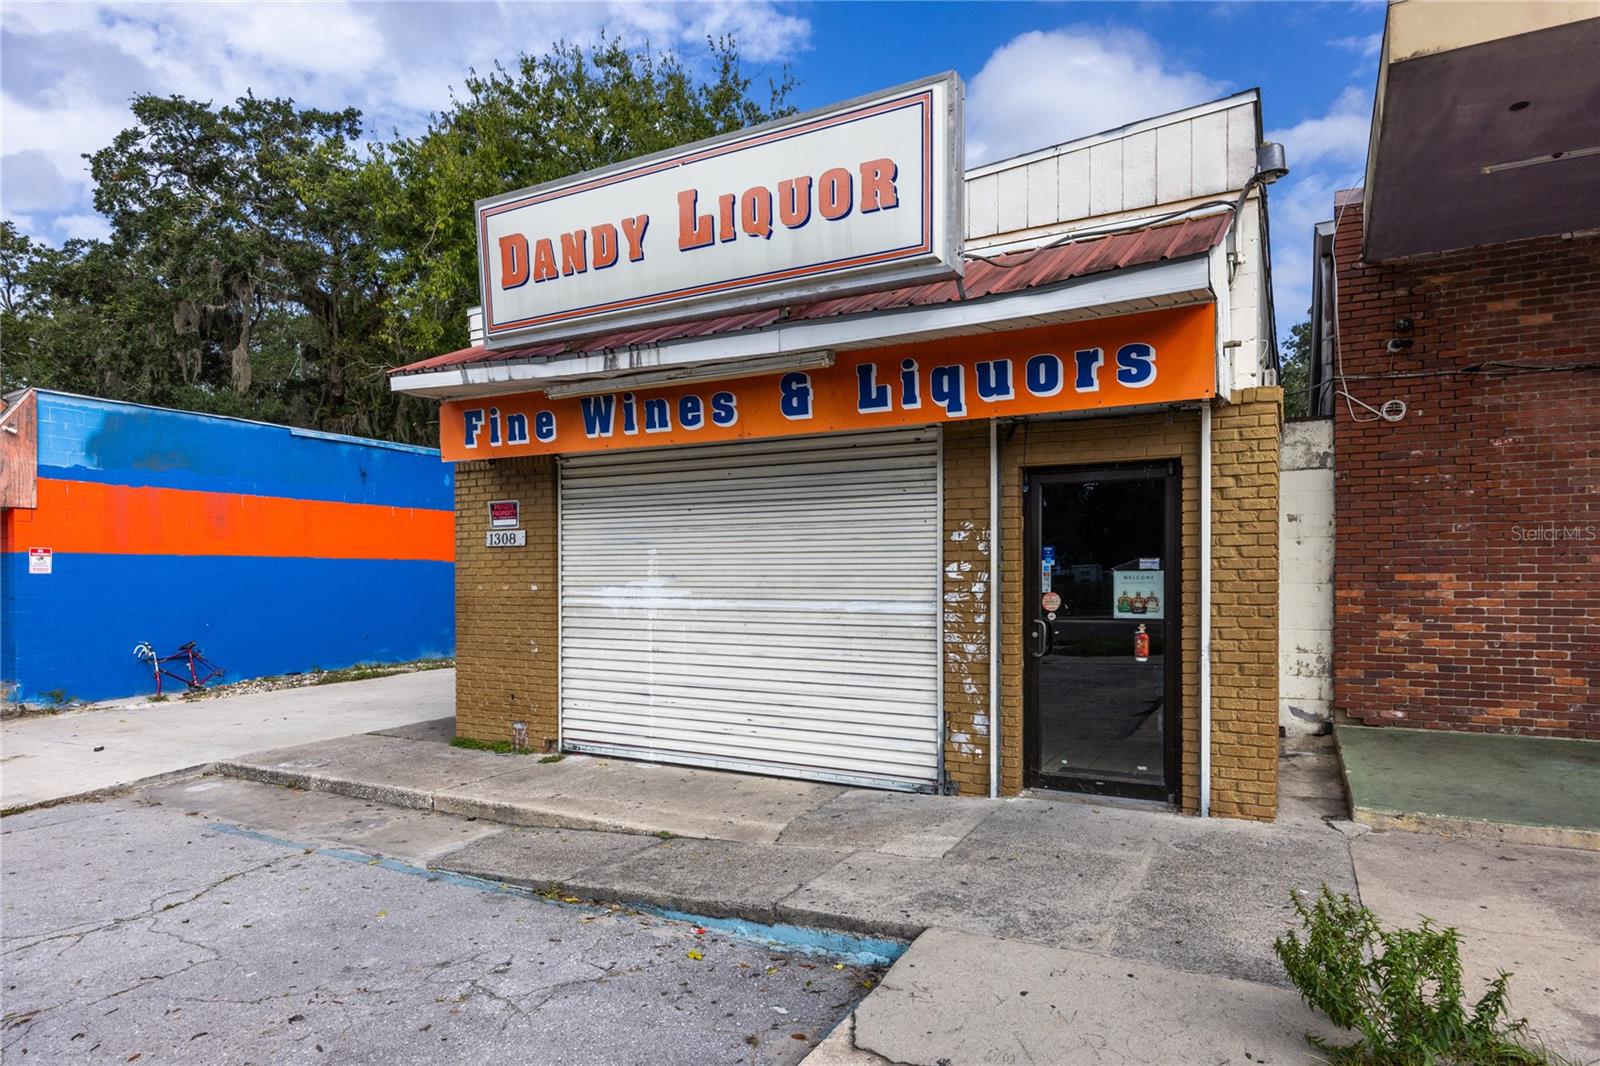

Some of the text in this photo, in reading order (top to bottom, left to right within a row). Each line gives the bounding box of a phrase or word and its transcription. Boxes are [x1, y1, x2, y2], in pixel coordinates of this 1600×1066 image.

[499, 158, 899, 290] DANDY LIQUOR
[464, 342, 1157, 449] Fine Wines & Liquors
[489, 533, 516, 545] 1308
